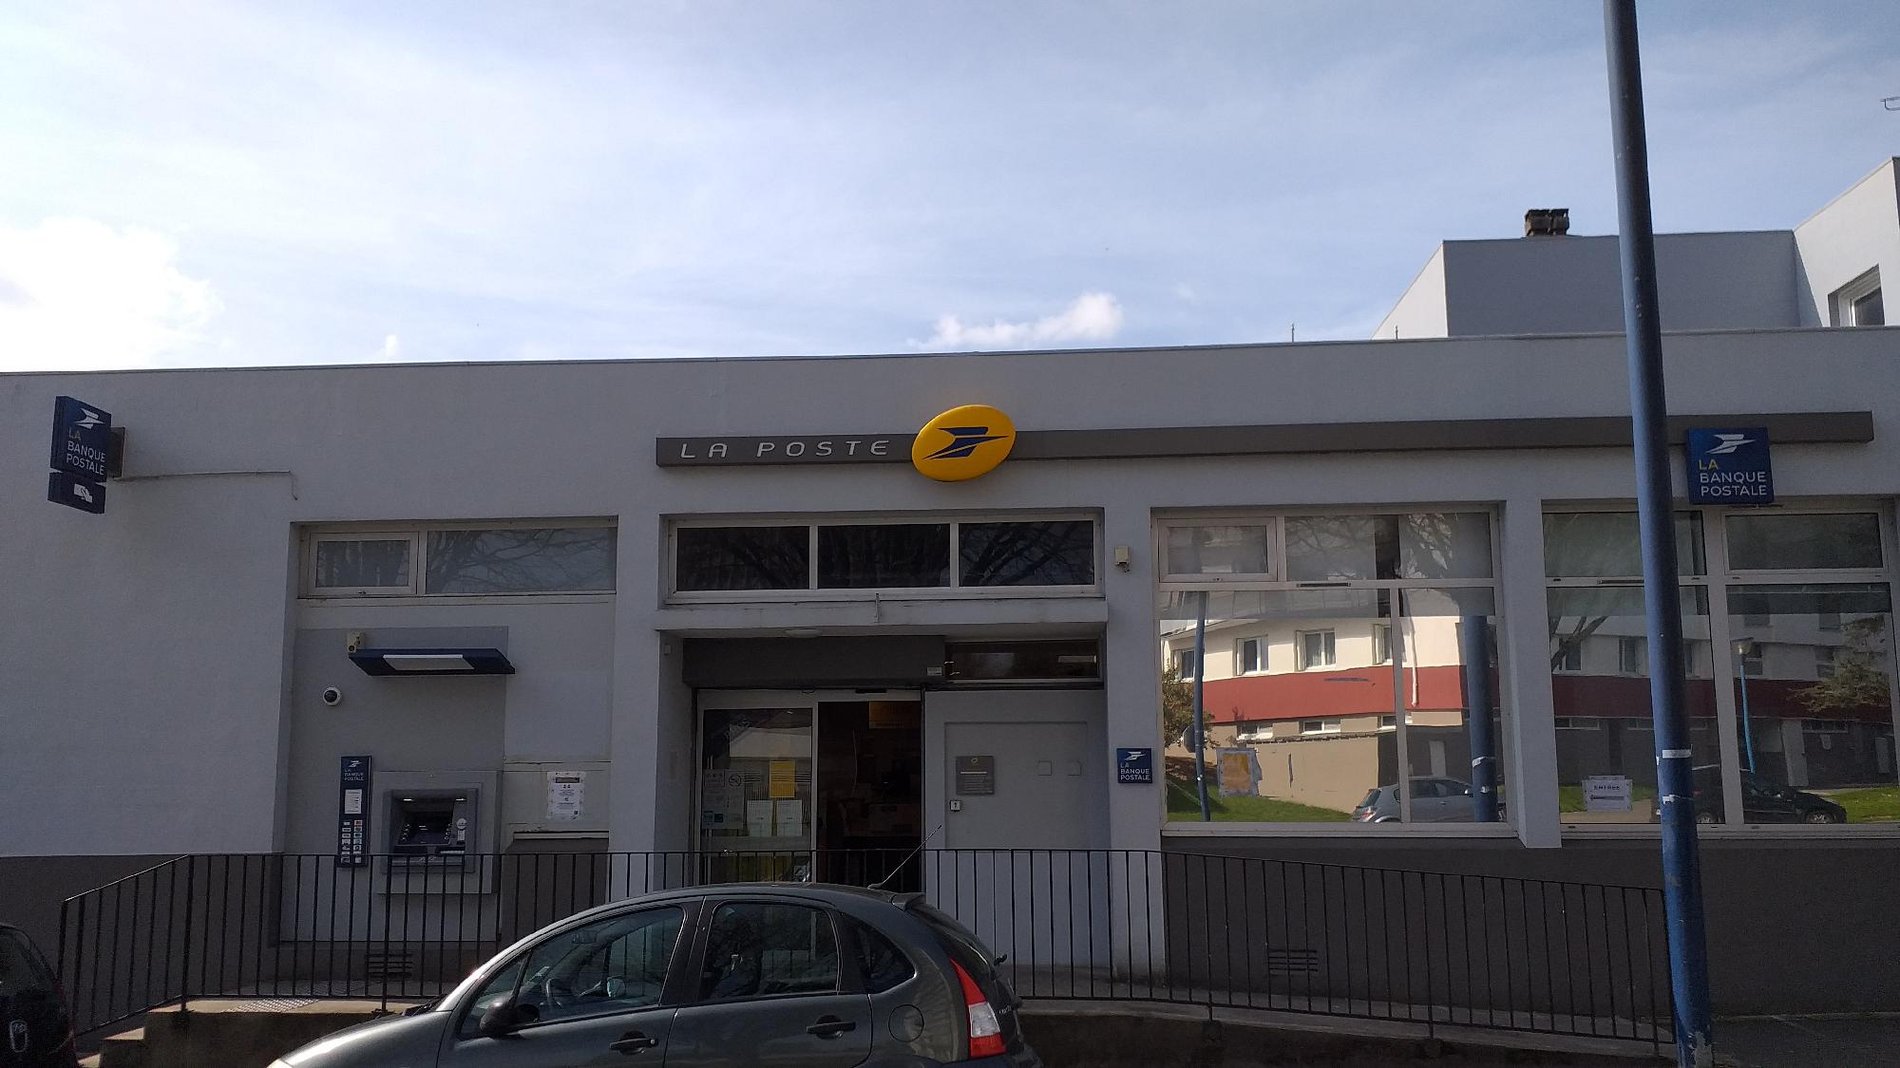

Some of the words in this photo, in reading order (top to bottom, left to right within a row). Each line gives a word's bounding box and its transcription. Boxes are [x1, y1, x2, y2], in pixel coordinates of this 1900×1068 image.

[68, 427, 81, 440] LA
[67, 441, 106, 462] BANQUE
[679, 442, 728, 458] LA
[756, 440, 890, 457] POSTE
[66, 453, 105, 475] POSTALE
[1698, 459, 1719, 470] LA
[1700, 471, 1767, 484] BANQUE
[1701, 484, 1767, 497] POSTALE
